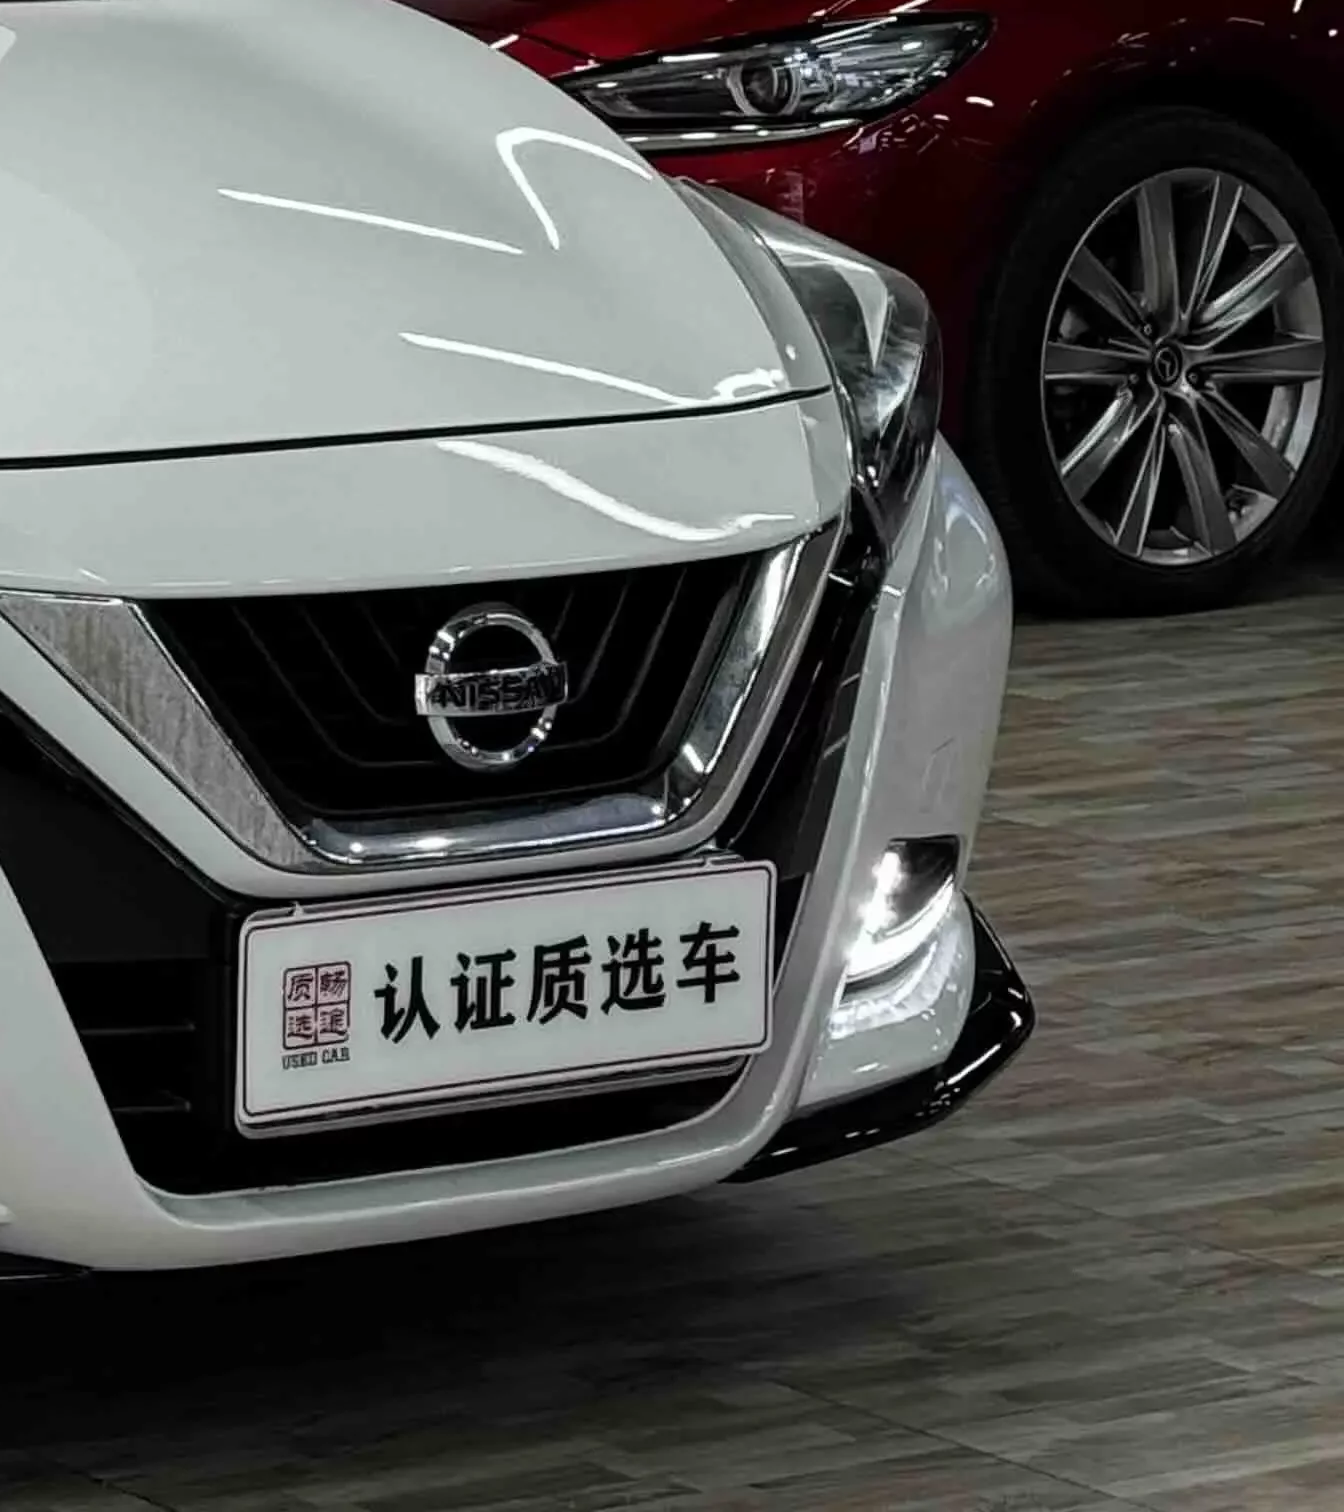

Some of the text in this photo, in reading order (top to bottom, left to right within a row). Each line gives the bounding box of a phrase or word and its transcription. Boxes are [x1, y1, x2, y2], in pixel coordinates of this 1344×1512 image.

[374, 921, 741, 1045] 认证质选车
